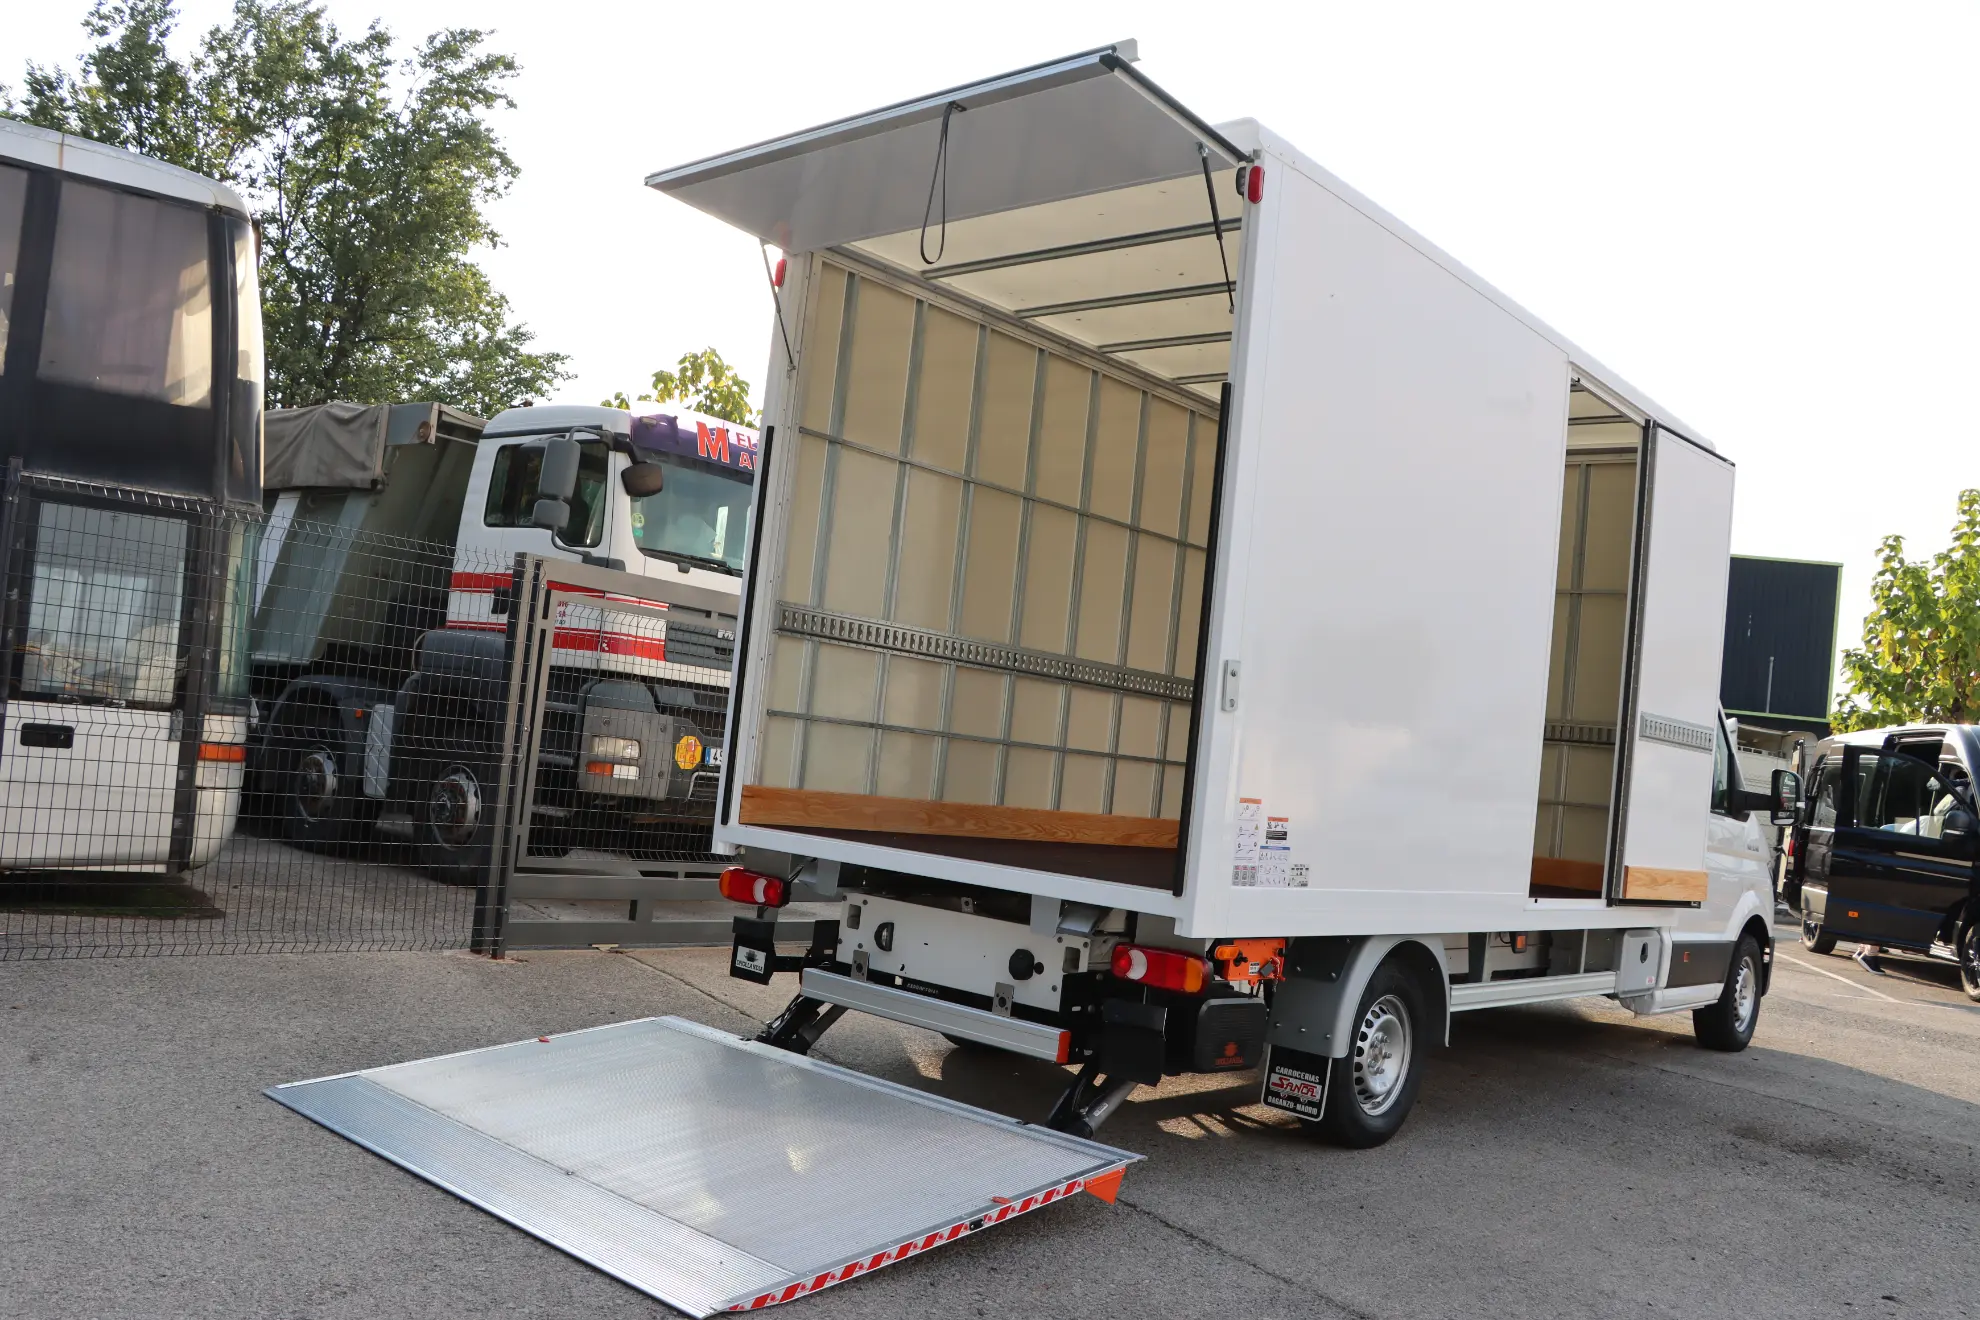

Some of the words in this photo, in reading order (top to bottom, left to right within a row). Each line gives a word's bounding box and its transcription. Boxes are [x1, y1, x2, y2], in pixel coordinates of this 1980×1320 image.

[696, 421, 730, 463] M
[736, 431, 758, 452] EL
[1275, 1065, 1320, 1083] CARROCERIAS
